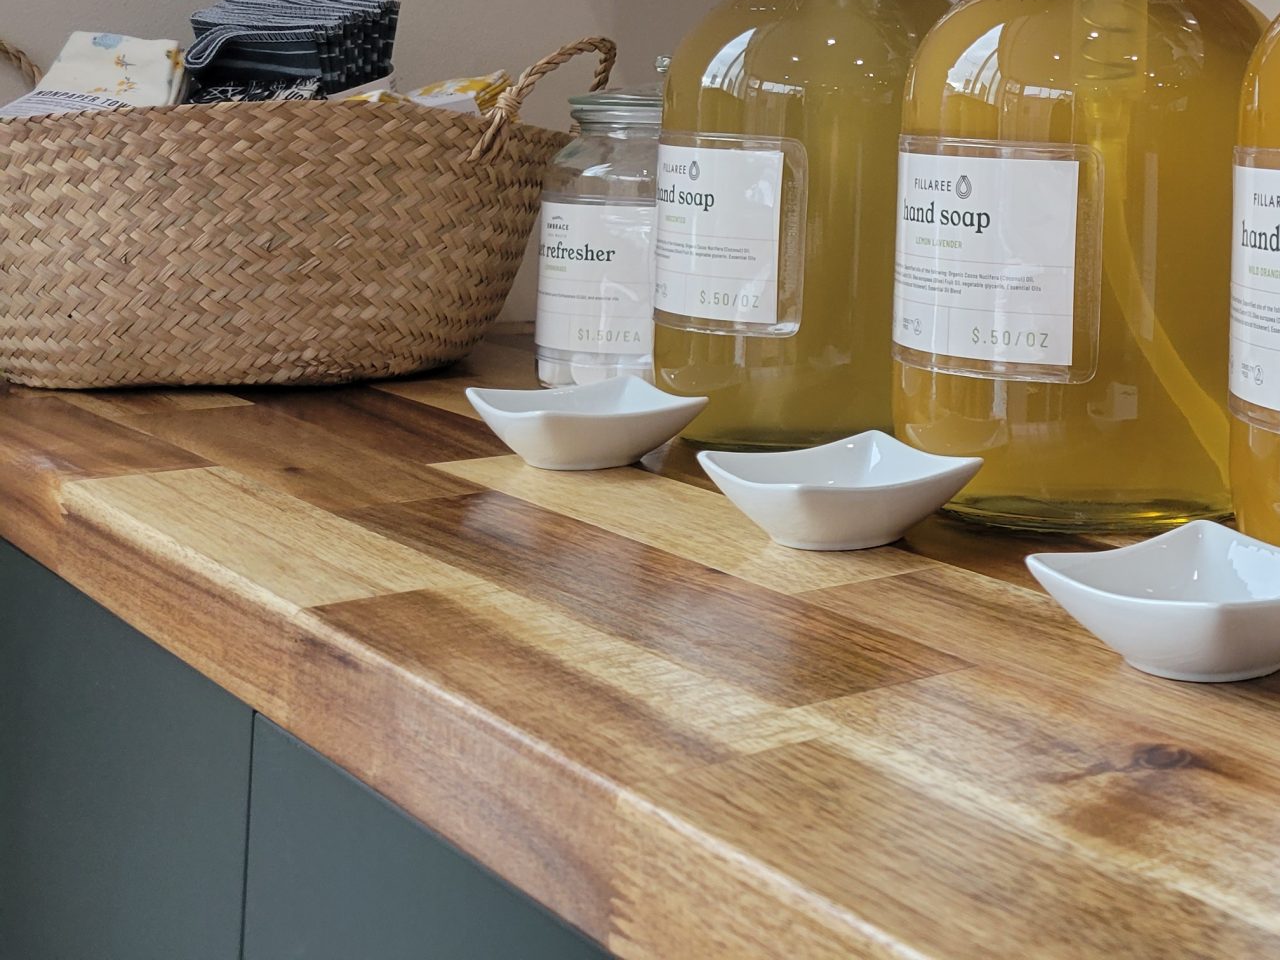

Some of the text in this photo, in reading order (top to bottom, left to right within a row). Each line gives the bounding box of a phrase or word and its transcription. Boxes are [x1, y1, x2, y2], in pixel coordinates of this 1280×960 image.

[34, 90, 132, 108] NONPAPER TOW
[914, 178, 952, 192] FILLAREE
[678, 191, 714, 211] soap
[903, 196, 990, 233] hand soap
[547, 223, 569, 231] EMBRACE
[1241, 219, 1280, 252] hand
[915, 236, 931, 246] LEMON
[547, 241, 616, 261] refresher
[699, 290, 759, 308] $.50/OZ
[577, 328, 641, 342] $1.50/EA
[972, 326, 1049, 348] $.50/OZ
